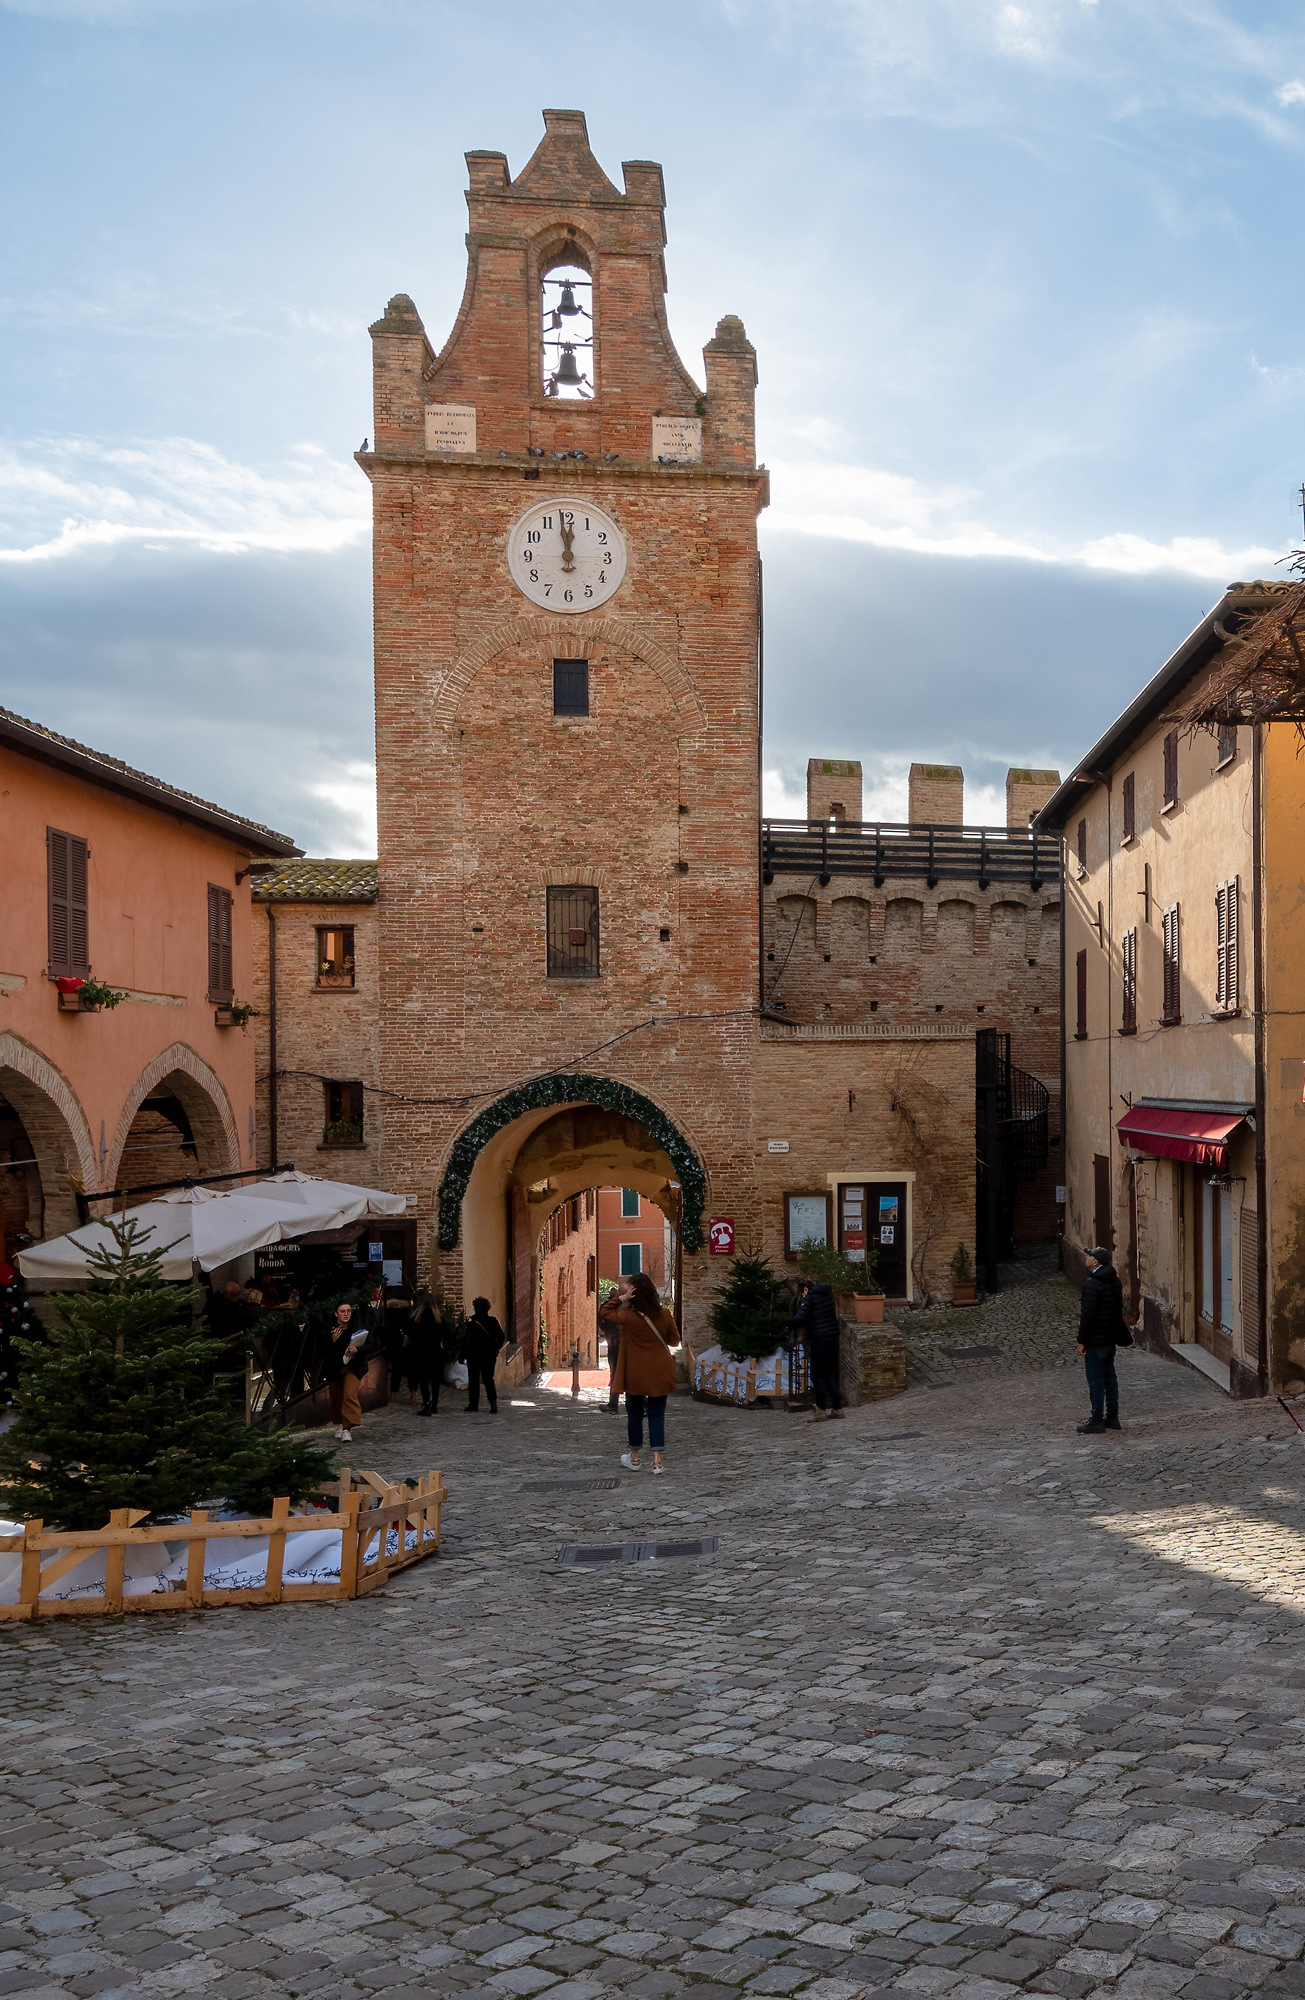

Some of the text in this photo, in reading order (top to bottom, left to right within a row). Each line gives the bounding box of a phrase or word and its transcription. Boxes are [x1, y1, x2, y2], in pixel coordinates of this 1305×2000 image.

[542, 517, 553, 529] 11
[561, 512, 575, 525] 12
[585, 518, 590, 530] 1
[527, 531, 541, 543] 10
[598, 532, 607, 545] 2
[524, 550, 532, 563] 9
[603, 552, 612, 564] 3
[530, 569, 539, 582] 8
[598, 571, 607, 583] 4
[544, 584, 553, 597] 7
[564, 590, 573, 602] 6
[584, 585, 593, 597] 5
